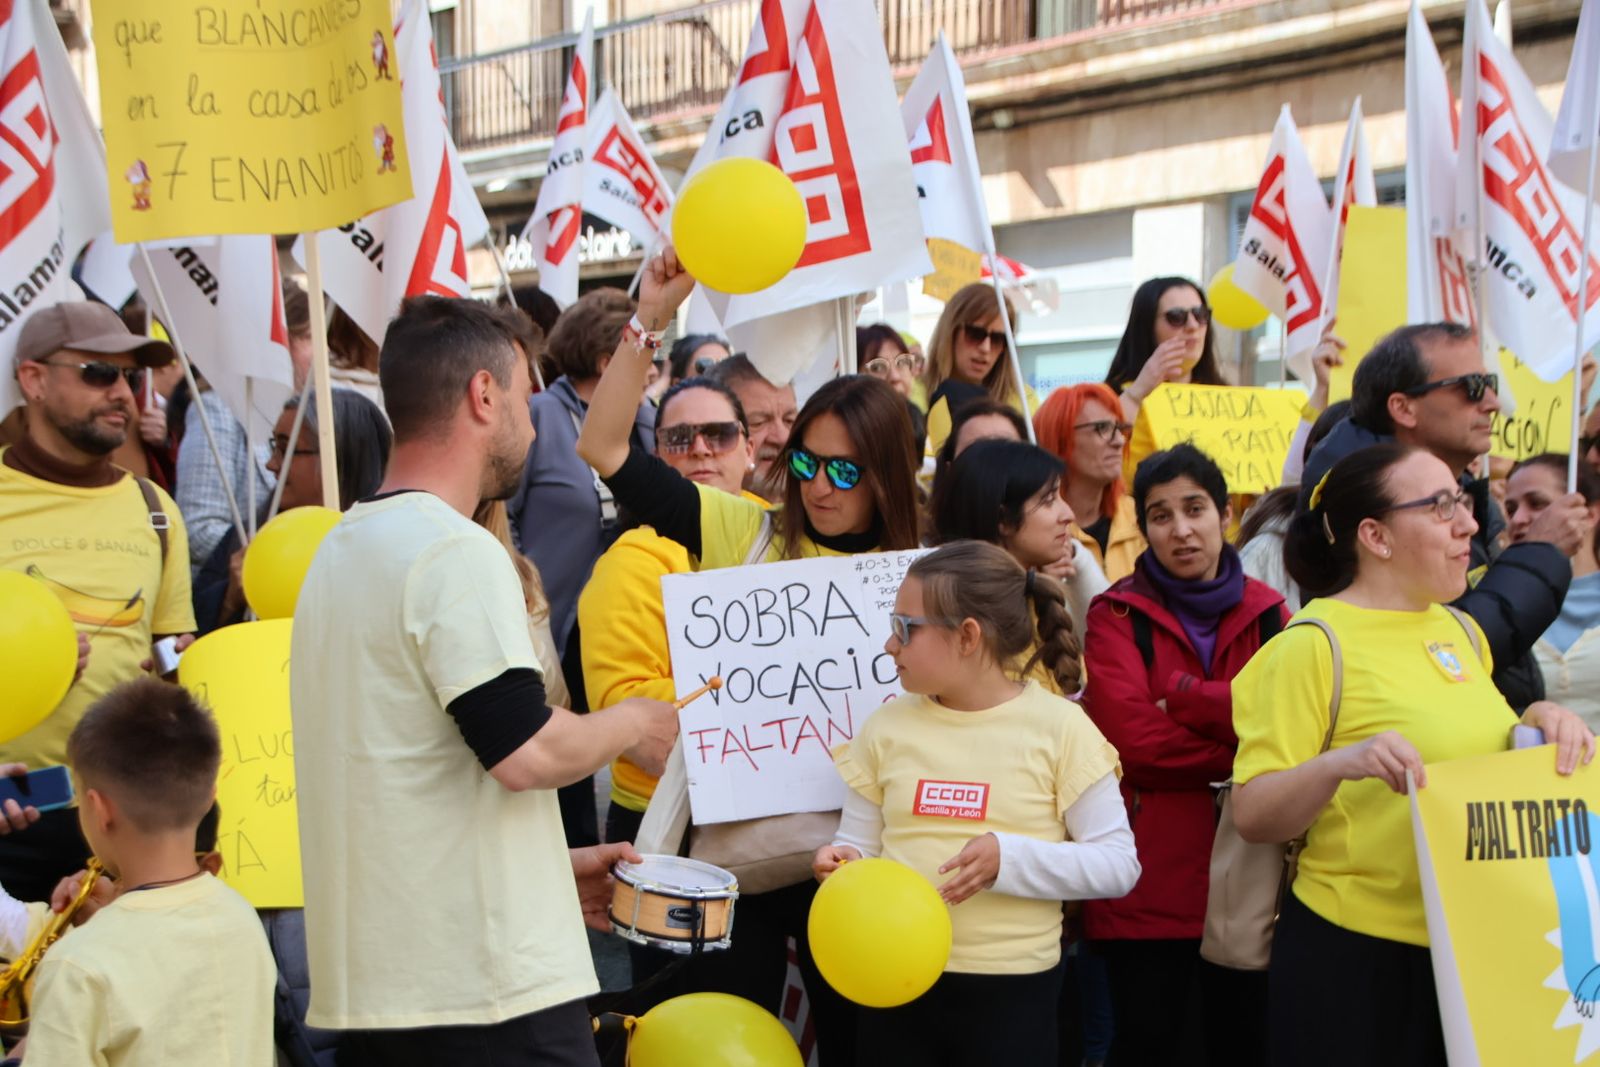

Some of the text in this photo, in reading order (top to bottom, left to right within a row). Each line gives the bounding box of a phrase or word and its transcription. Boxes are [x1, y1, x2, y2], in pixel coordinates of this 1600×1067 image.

[114, 19, 163, 68] que
[187, 73, 222, 116] la
[248, 88, 322, 119] casa
[156, 141, 188, 201] 7
[600, 176, 641, 208] Sala
[1244, 237, 1288, 284] Sala
[12, 537, 73, 552] DOLCE
[95, 539, 149, 558] BANANA
[684, 580, 871, 650] SOBRA
[688, 692, 854, 772] FALTAN
[919, 804, 982, 819] Castilla y León
[926, 787, 979, 803] CCOO
[1465, 798, 1592, 862] MALTRATO
